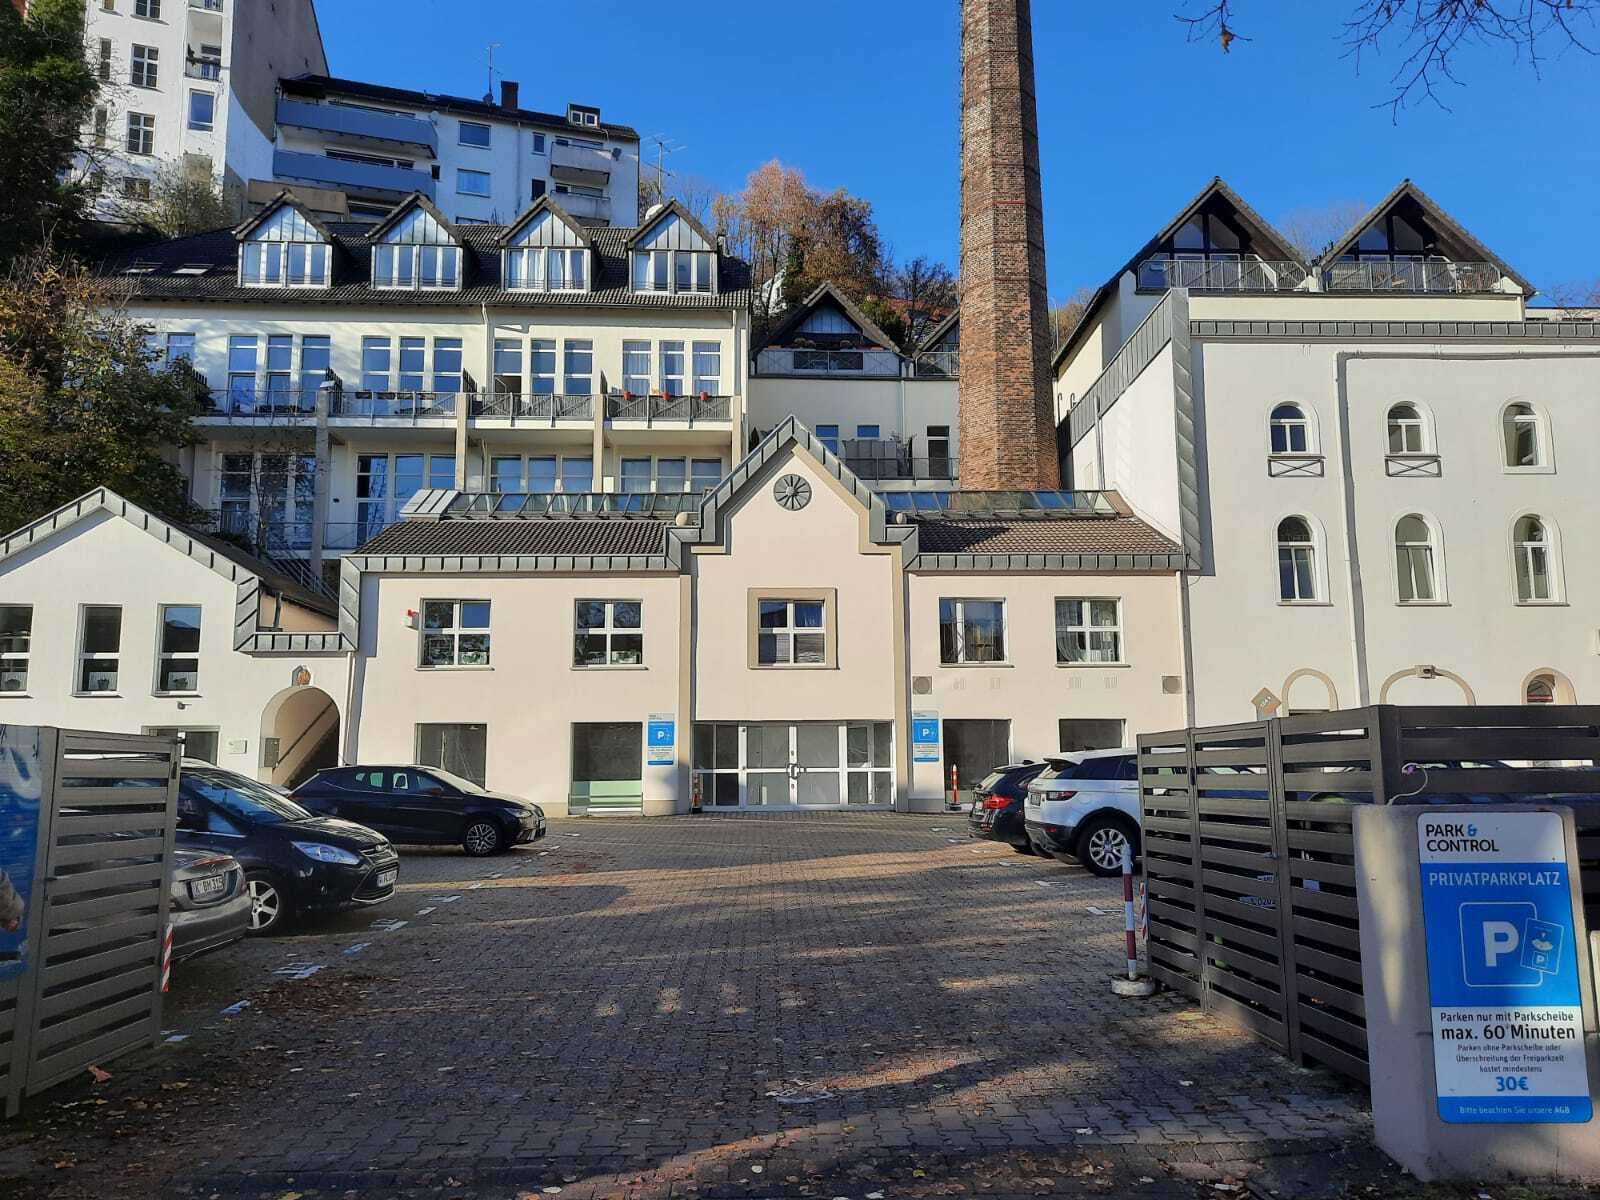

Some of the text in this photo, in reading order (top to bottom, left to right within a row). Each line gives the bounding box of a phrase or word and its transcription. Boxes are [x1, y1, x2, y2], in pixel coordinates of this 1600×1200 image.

[1426, 824, 1477, 837] PARK &
[1427, 839, 1500, 852] CONTROL
[1429, 871, 1561, 886] PRIVATPARKPLATZ
[1482, 920, 1519, 967] P
[1440, 1011, 1574, 1022] Parken nur mit Parkscheibe
[1441, 1024, 1576, 1040] max. 60 Minuten
[1456, 1054, 1509, 1063] Überschreitung
[1495, 1076, 1529, 1092] 30€
